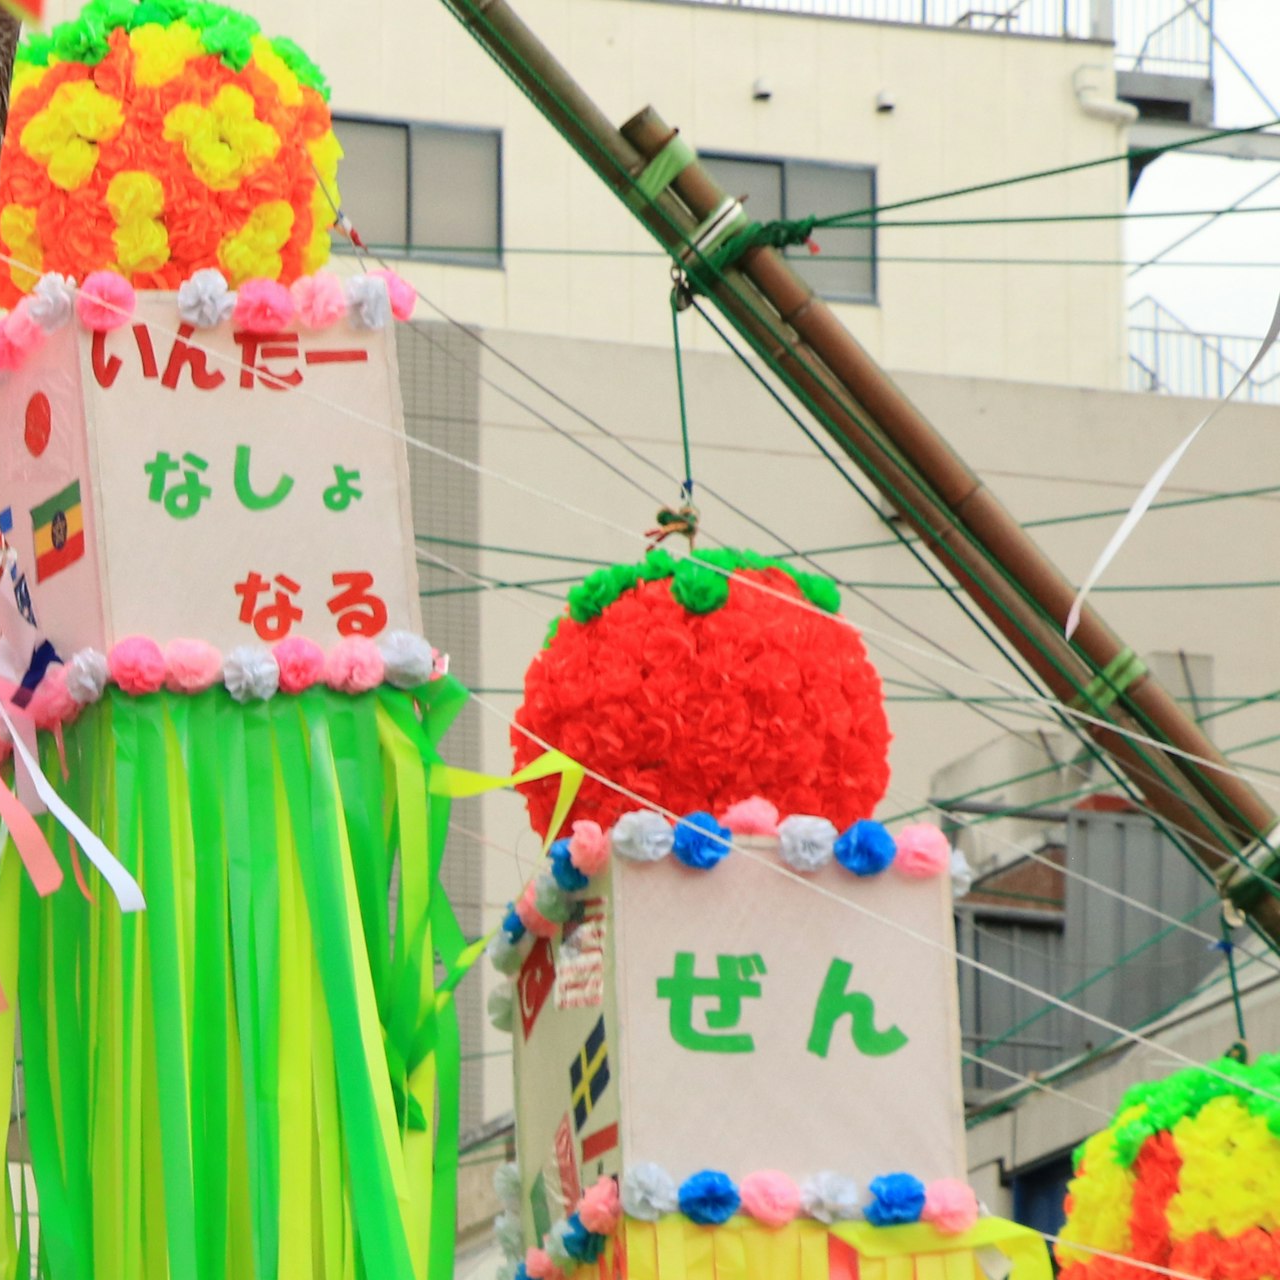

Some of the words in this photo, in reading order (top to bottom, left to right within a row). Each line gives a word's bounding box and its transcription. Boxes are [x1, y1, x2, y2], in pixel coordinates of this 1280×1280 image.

[91, 323, 369, 391] いんたー
[143, 444, 364, 520] なしょ
[234, 570, 389, 642] なる
[655, 950, 910, 1059] ぜん
